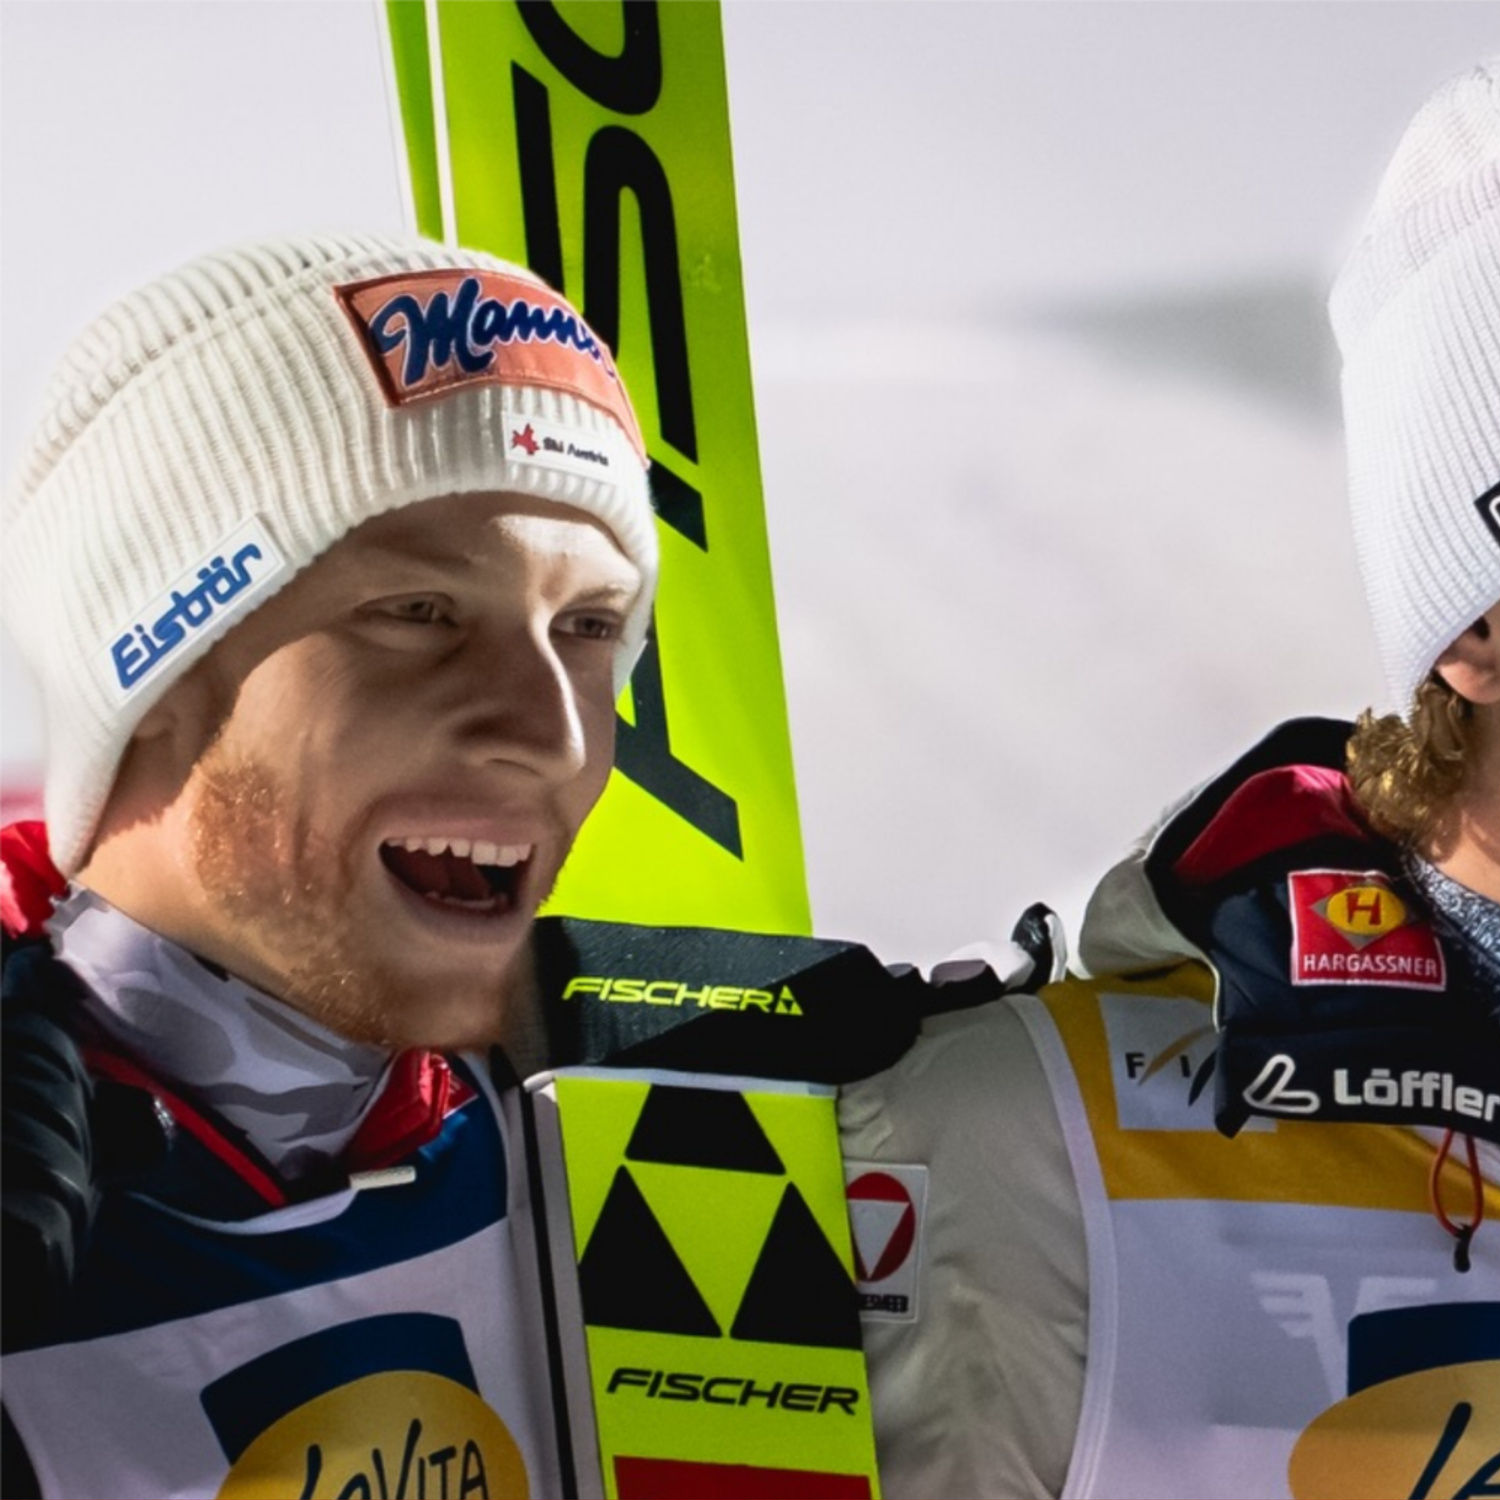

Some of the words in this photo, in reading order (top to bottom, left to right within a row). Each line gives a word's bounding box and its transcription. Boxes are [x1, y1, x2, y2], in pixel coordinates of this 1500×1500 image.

[1302, 952, 1438, 979] HARGASSNER
[562, 975, 773, 1013] FISCHER
[606, 1366, 860, 1416] FISCHER
